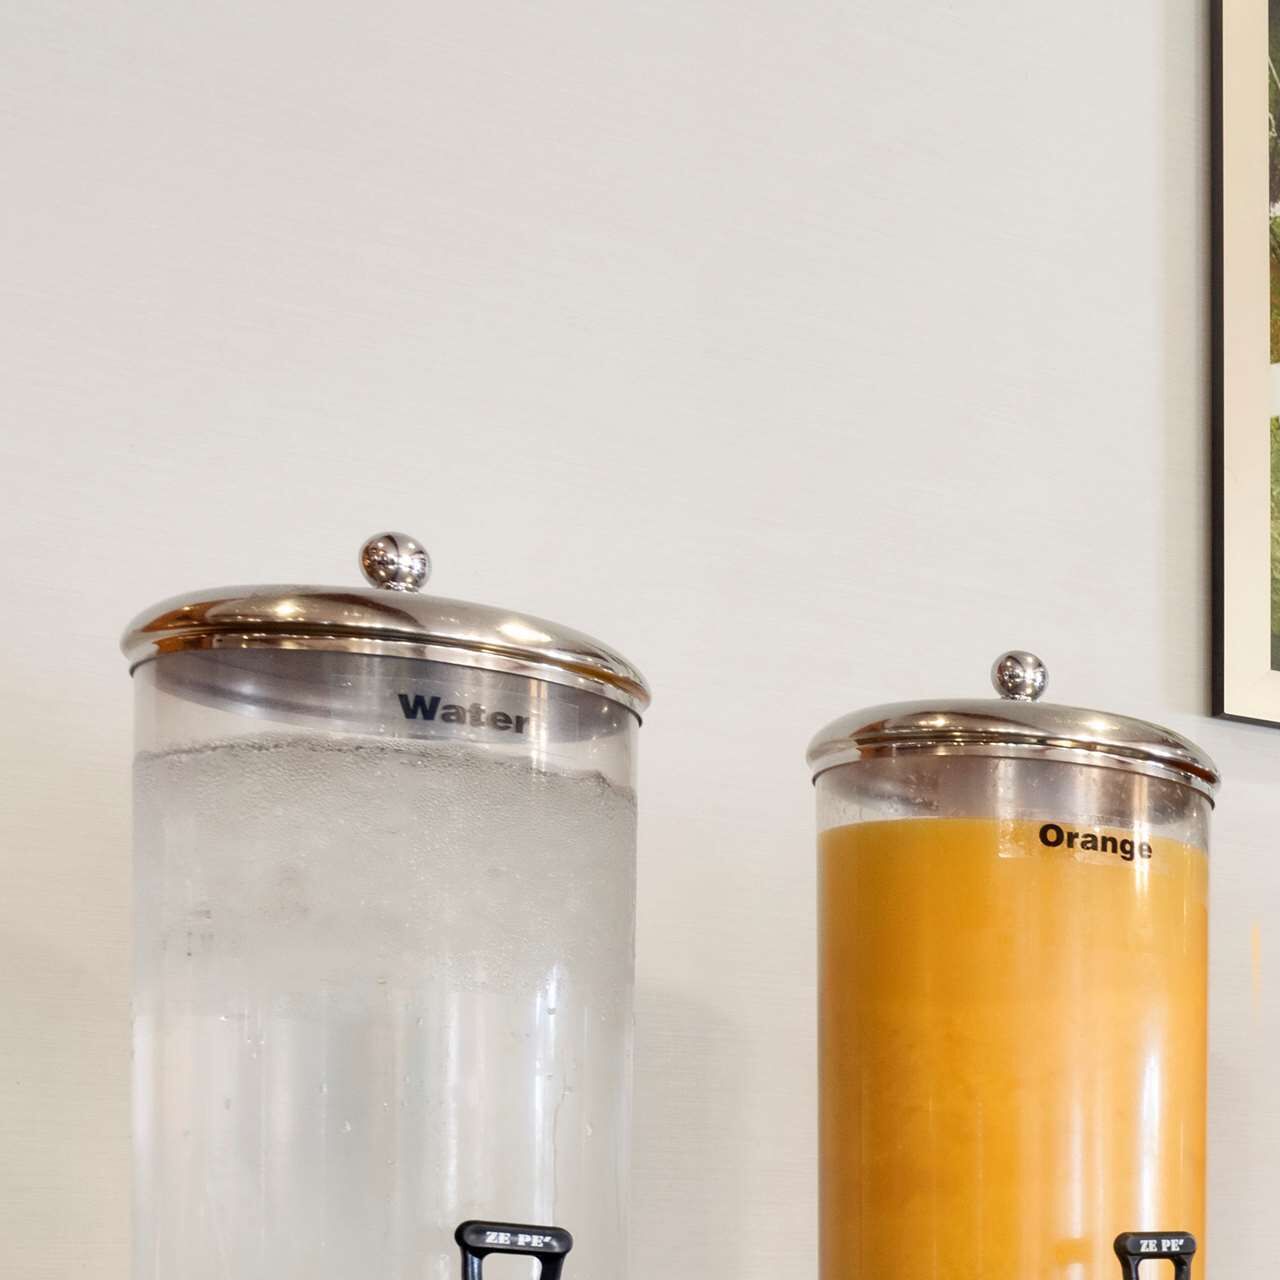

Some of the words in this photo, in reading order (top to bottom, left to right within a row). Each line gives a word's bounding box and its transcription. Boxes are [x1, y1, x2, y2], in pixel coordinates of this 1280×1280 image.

[398, 693, 530, 734] Water
[1039, 823, 1152, 861] Orange
[485, 1231, 511, 1245] ZE
[1140, 1239, 1158, 1253] ZE
